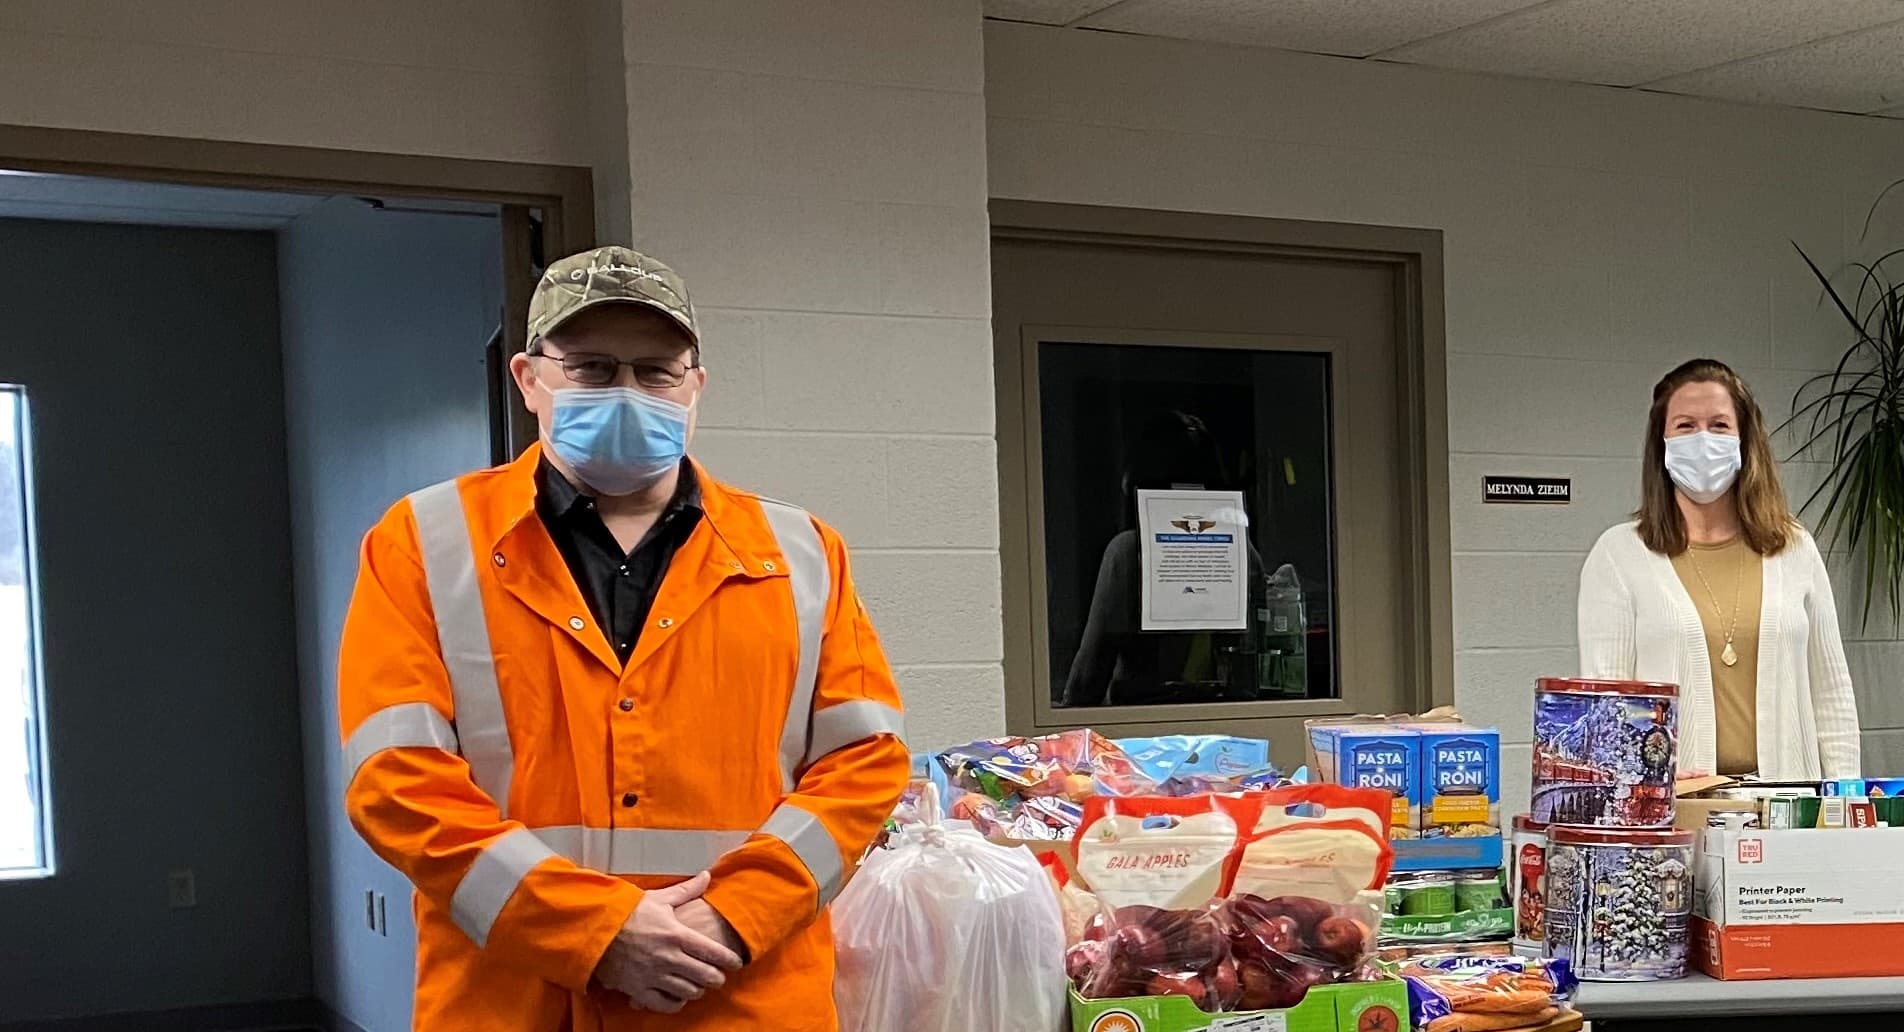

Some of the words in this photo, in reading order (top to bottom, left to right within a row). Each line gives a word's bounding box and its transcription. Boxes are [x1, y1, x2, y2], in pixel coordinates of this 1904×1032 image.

[1487, 484, 1534, 495] MELYNDA
[1537, 485, 1568, 495] ZIEHM
[1358, 752, 1402, 765] PASTA
[1439, 750, 1482, 763] PASTA
[1359, 773, 1402, 788] RONI
[1440, 771, 1481, 785] RONI
[1107, 856, 1138, 869] GALA
[1143, 853, 1191, 869] APPLES
[1739, 886, 1774, 896] Printer
[1776, 885, 1806, 897] Paper
